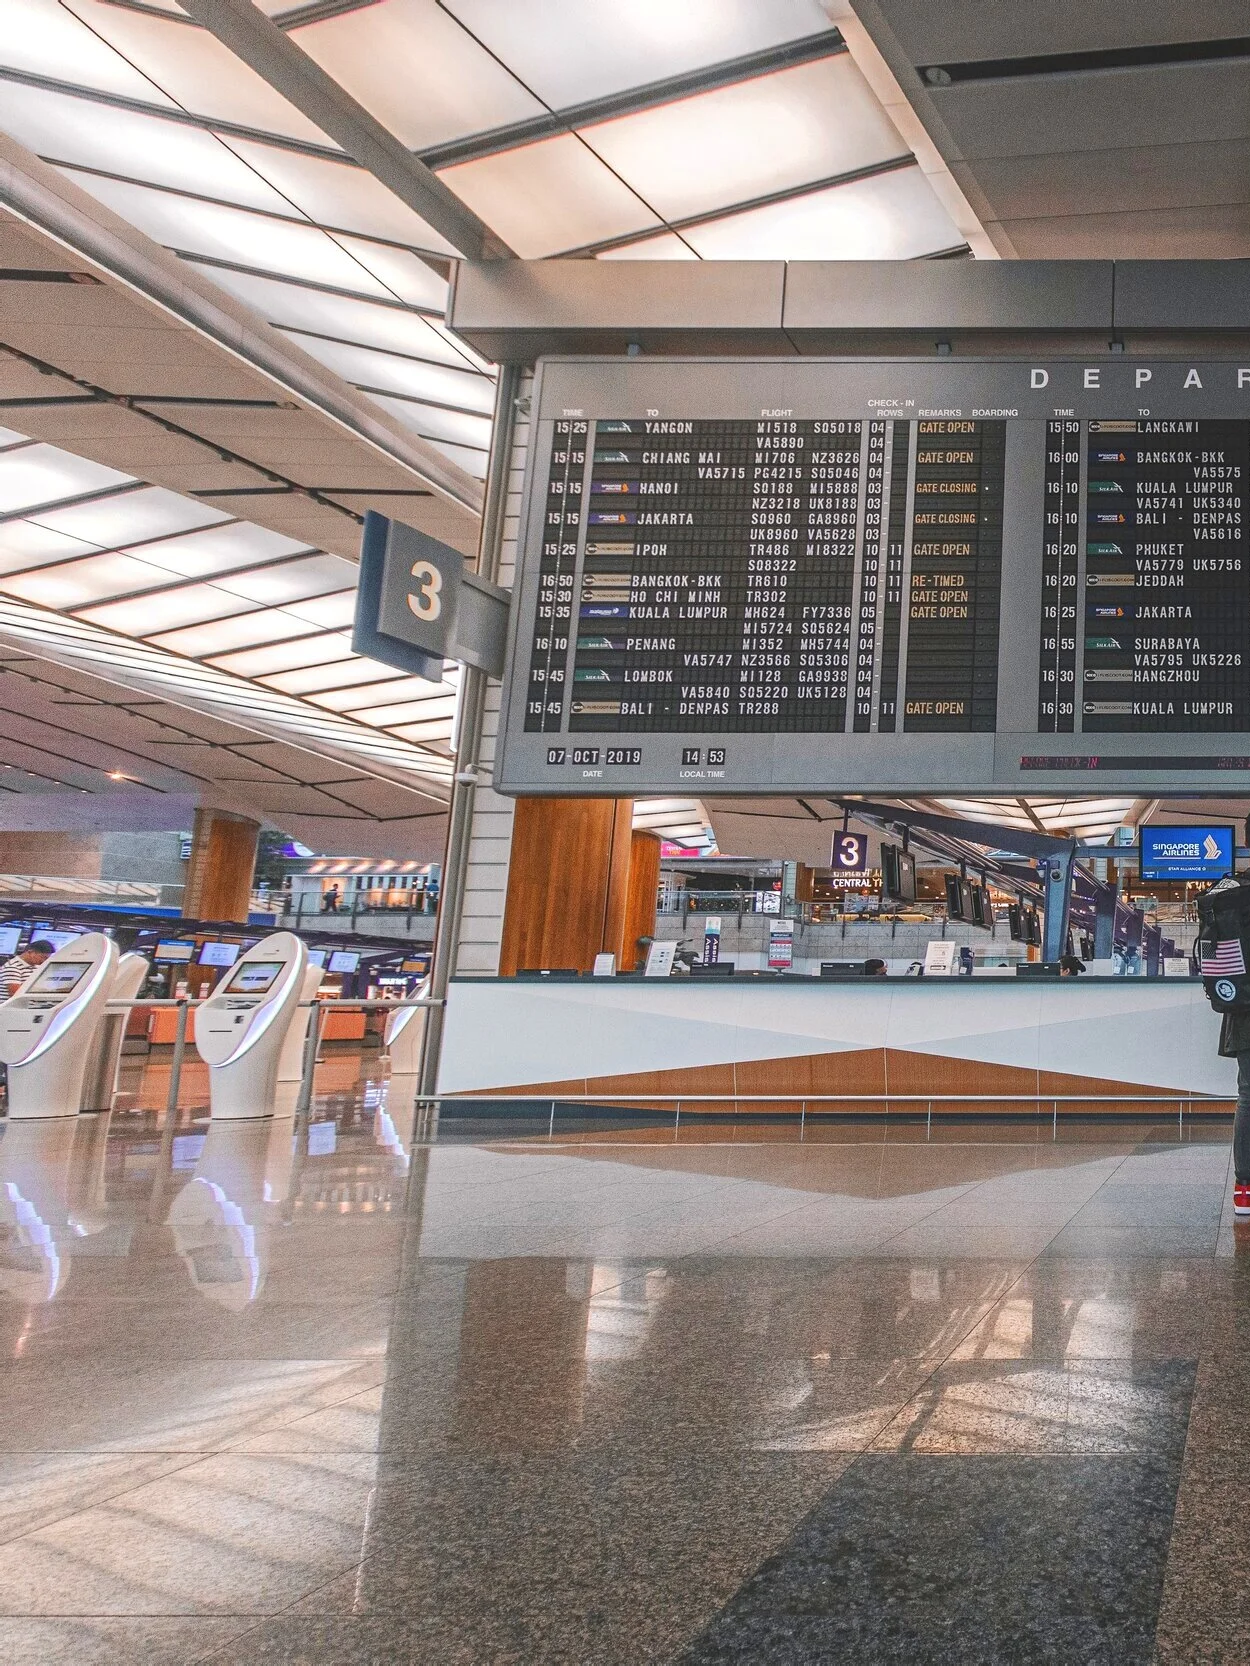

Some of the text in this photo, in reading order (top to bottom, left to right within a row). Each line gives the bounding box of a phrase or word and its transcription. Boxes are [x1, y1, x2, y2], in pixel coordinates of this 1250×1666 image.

[563, 409, 1018, 417] TIME TO FLIGHT ROWS REMARKS BOARDING
[1053, 408, 1074, 416] TIME
[1138, 408, 1150, 416] TO
[646, 422, 693, 434] YANGON
[758, 422, 797, 434] MI518
[814, 422, 861, 434] SQ5018
[919, 422, 944, 433] GATE
[947, 422, 975, 433] OPEN
[1138, 421, 1199, 433] LANGKAWI
[757, 436, 804, 449] VA5890
[643, 451, 721, 464] CHIANG MAI
[1137, 451, 1225, 464] BANGKOK-BKK
[1194, 466, 1241, 479] VA5575
[640, 482, 976, 495] HANOI SQ188 MI5888 GATE CLOSING
[1137, 481, 1233, 494] KUALA LUMPUR
[638, 512, 694, 525] JAKARTA
[1137, 512, 1166, 525] BALI
[1194, 512, 1242, 525] DENPAS
[635, 543, 668, 556] IPOH
[1136, 543, 1185, 556] PHUKET
[1136, 559, 1184, 571] VA5779
[1193, 558, 1242, 571] UK5756
[632, 574, 722, 587] BANGKOK-BKK
[911, 575, 964, 587] RE-TIMED
[1136, 574, 1184, 587] JEDDAH
[407, 560, 443, 622] 3
[630, 590, 721, 603] HO CHI MINH
[629, 606, 728, 619] KUALA LUMPUR
[1136, 606, 1192, 619] JAKARTA
[627, 637, 676, 651] PENANG
[1135, 637, 1201, 650] SURABAYA
[684, 653, 849, 667] VA5747 NZ3566 SQ5306
[625, 670, 674, 683] LOMBOK
[1134, 669, 1200, 683] HANGZHOU
[621, 702, 653, 715] BALI
[680, 702, 729, 715] DENPAS
[739, 702, 779, 715] TR288
[906, 702, 933, 714] GATE
[935, 702, 964, 714] OPEN
[1134, 701, 1233, 715] KUALA LUMPUR
[582, 770, 603, 778] DATE
[680, 770, 725, 778] LOCAL TIME
[840, 836, 860, 866] 3
